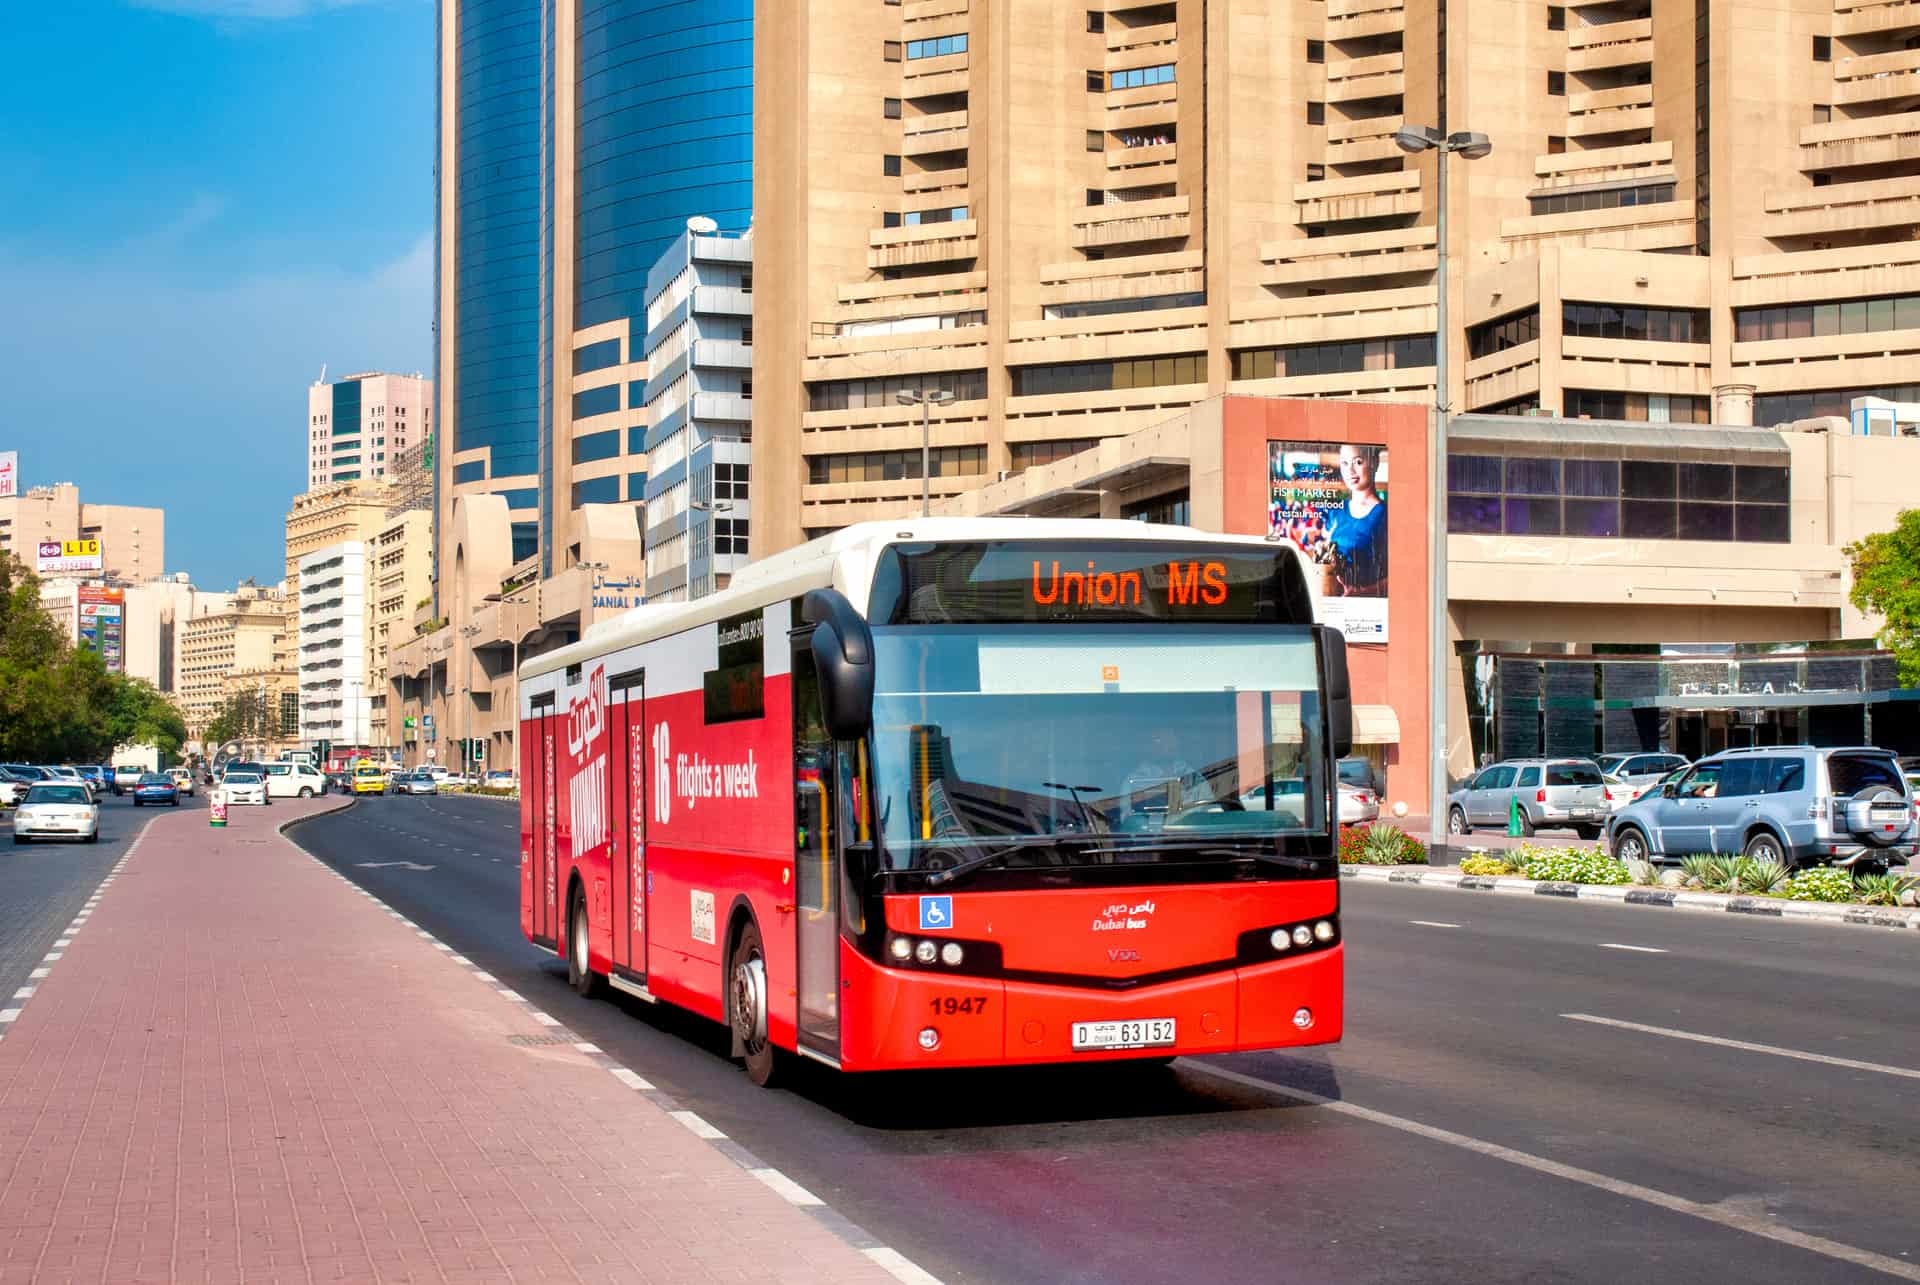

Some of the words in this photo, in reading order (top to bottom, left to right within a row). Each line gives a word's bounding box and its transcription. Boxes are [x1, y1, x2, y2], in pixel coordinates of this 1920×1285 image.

[1273, 487, 1295, 497] FISH
[1297, 487, 1338, 498] MARKET
[1310, 499, 1345, 510] seafood
[1278, 509, 1323, 519] restaurant
[66, 541, 97, 553] LIC
[1033, 560, 1141, 605] Union
[1167, 560, 1228, 605] MS
[592, 596, 631, 609] DANIAL
[567, 664, 606, 766] الكويت
[652, 721, 670, 825] 16
[677, 751, 713, 809] flights
[714, 763, 722, 798] a
[723, 748, 759, 798] week
[569, 752, 606, 859] KUWAIT
[1103, 903, 1127, 918] دبي
[1129, 899, 1155, 915] باص
[1092, 918, 1126, 931] Dubai
[1126, 917, 1147, 929] bus
[1107, 949, 1142, 961] VDL
[929, 997, 987, 1015] 1947
[1079, 1026, 1088, 1044] D
[1121, 1021, 1173, 1042] 63152
